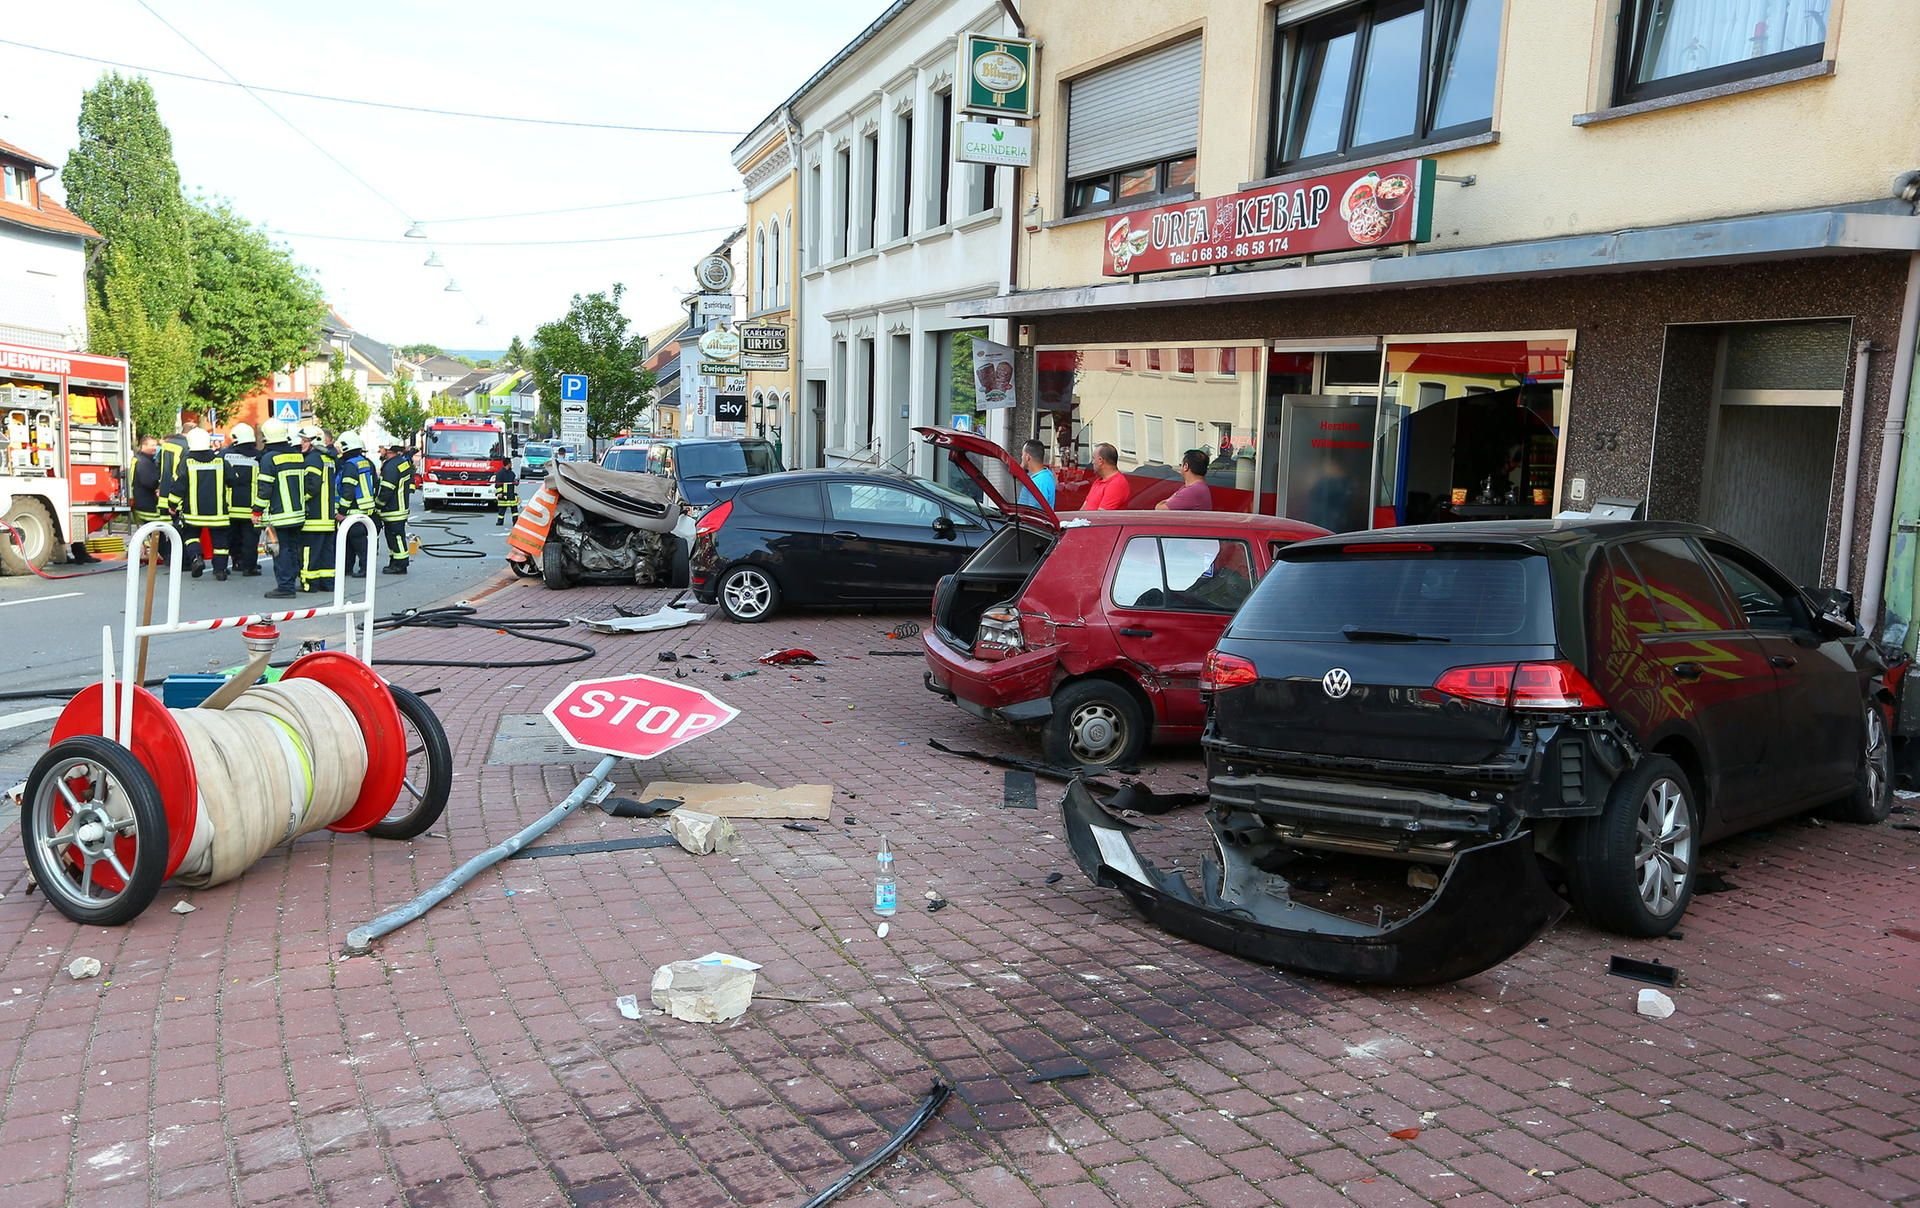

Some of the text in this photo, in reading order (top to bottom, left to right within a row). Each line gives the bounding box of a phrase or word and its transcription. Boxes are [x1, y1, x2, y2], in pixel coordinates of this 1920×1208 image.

[967, 142, 1027, 157] CARINDERIA
[1152, 185, 1331, 250] URFA KEBAP
[1171, 253, 1190, 265] Tel.:
[1192, 249, 1198, 262] 0
[1200, 247, 1212, 261] 68
[1215, 245, 1228, 259] 38
[1236, 243, 1249, 257] 86
[1252, 240, 1265, 255] 58
[1268, 237, 1289, 253] 174
[744, 329, 785, 337] KARLSBERG
[748, 338, 783, 350] UR-PILS
[568, 378, 582, 398] P
[720, 401, 743, 416] sky
[569, 690, 717, 740] STOP
